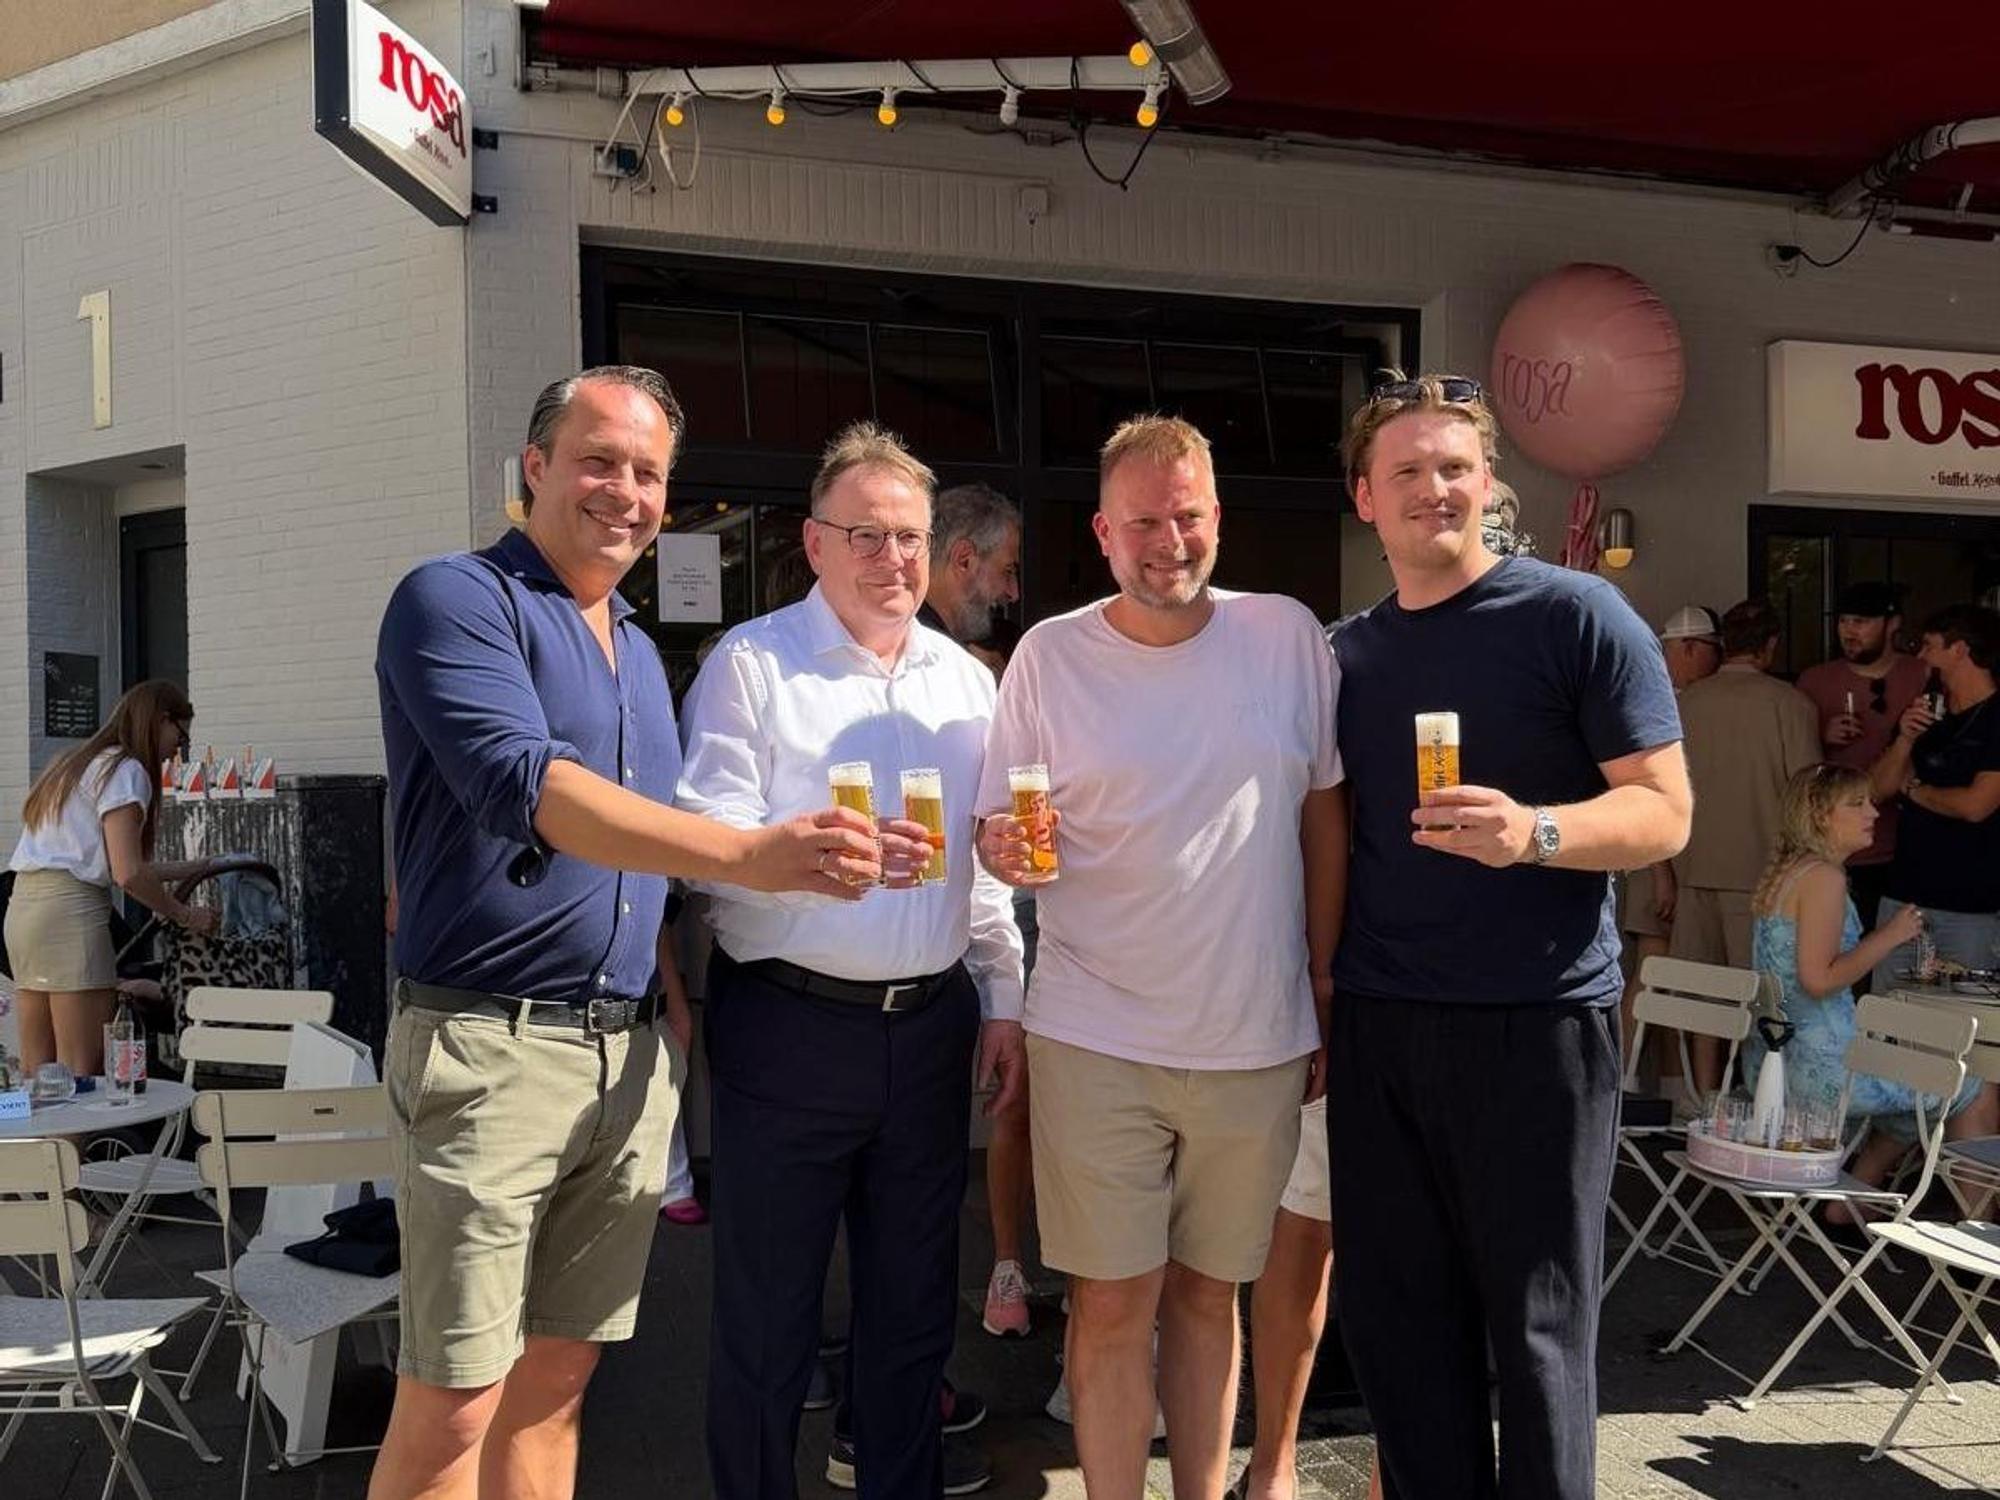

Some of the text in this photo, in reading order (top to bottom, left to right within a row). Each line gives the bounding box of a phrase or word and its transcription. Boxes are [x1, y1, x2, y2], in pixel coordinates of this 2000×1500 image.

[378, 32, 466, 158] rosa
[78, 289, 112, 430] 1
[1502, 352, 1575, 424] rosa
